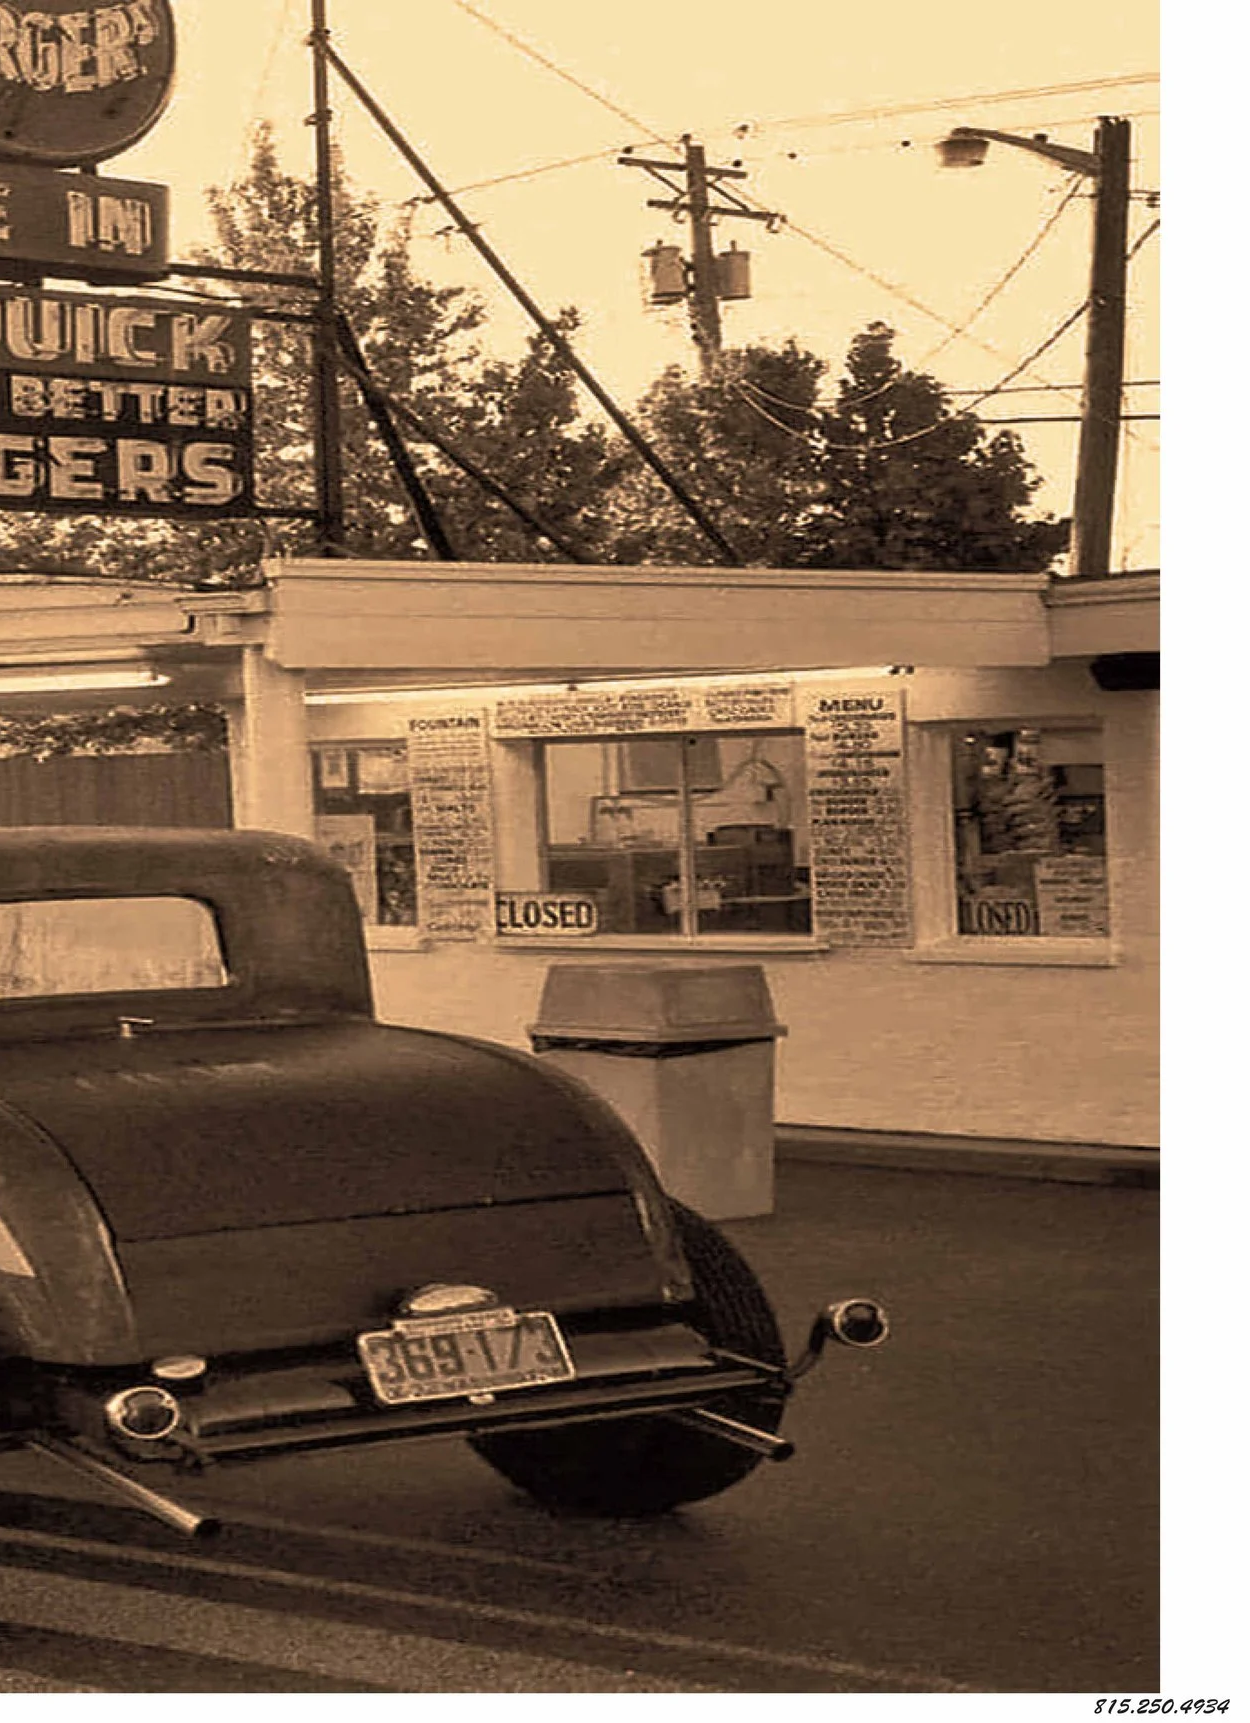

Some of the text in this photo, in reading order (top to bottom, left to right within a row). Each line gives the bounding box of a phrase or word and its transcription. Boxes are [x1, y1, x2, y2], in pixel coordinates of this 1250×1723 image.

[67, 190, 152, 256] IN
[10, 374, 248, 430] BETTER
[818, 697, 884, 712] MENU
[408, 716, 480, 732] FOUNTAIN
[496, 900, 593, 928] CLOSED
